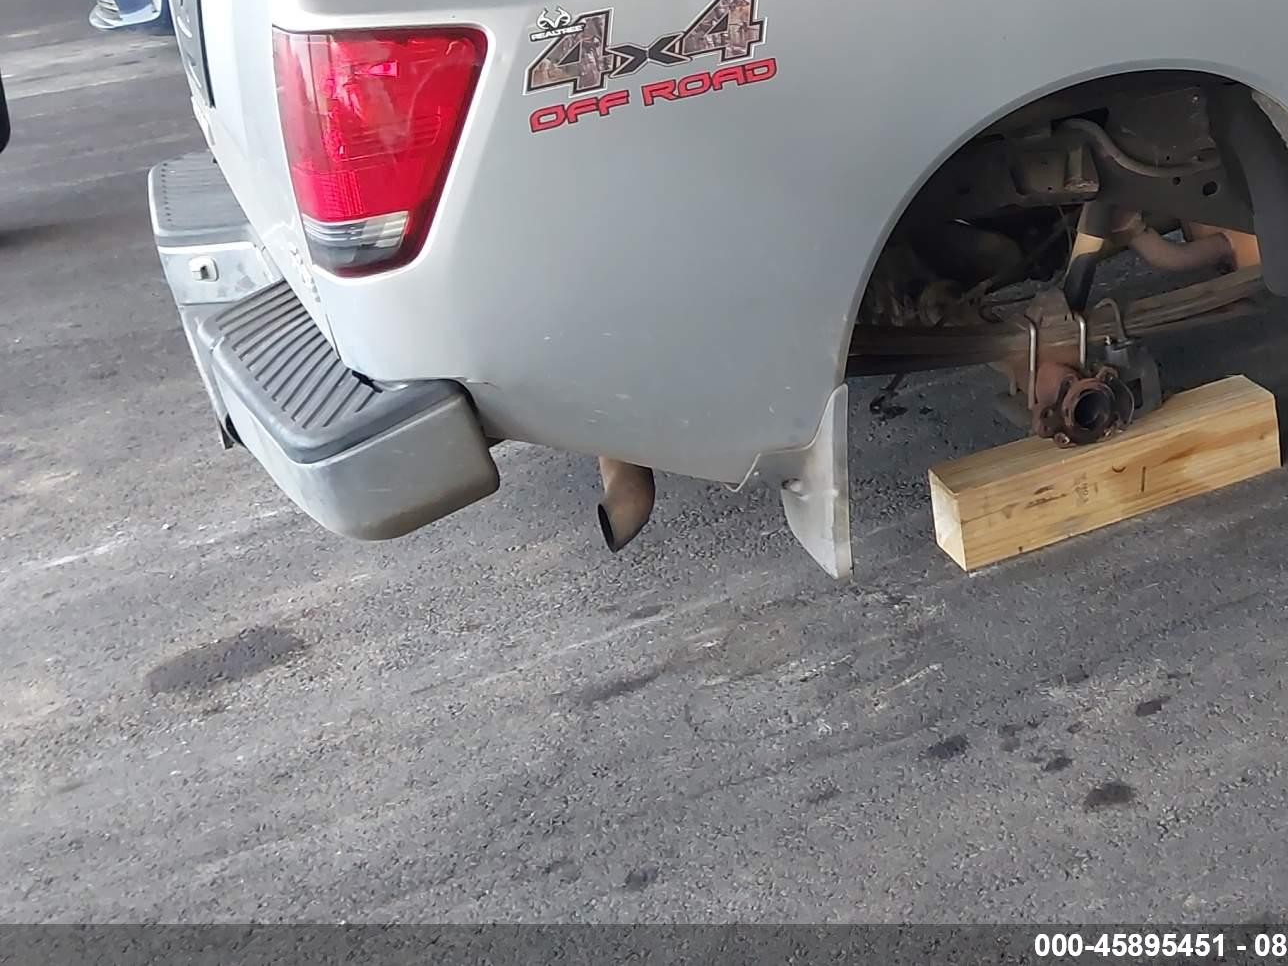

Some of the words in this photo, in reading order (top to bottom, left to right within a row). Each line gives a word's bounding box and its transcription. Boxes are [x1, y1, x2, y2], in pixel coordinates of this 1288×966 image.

[531, 24, 585, 41] REALTREE
[530, 90, 629, 133] OFF
[641, 58, 777, 106] ROAD
